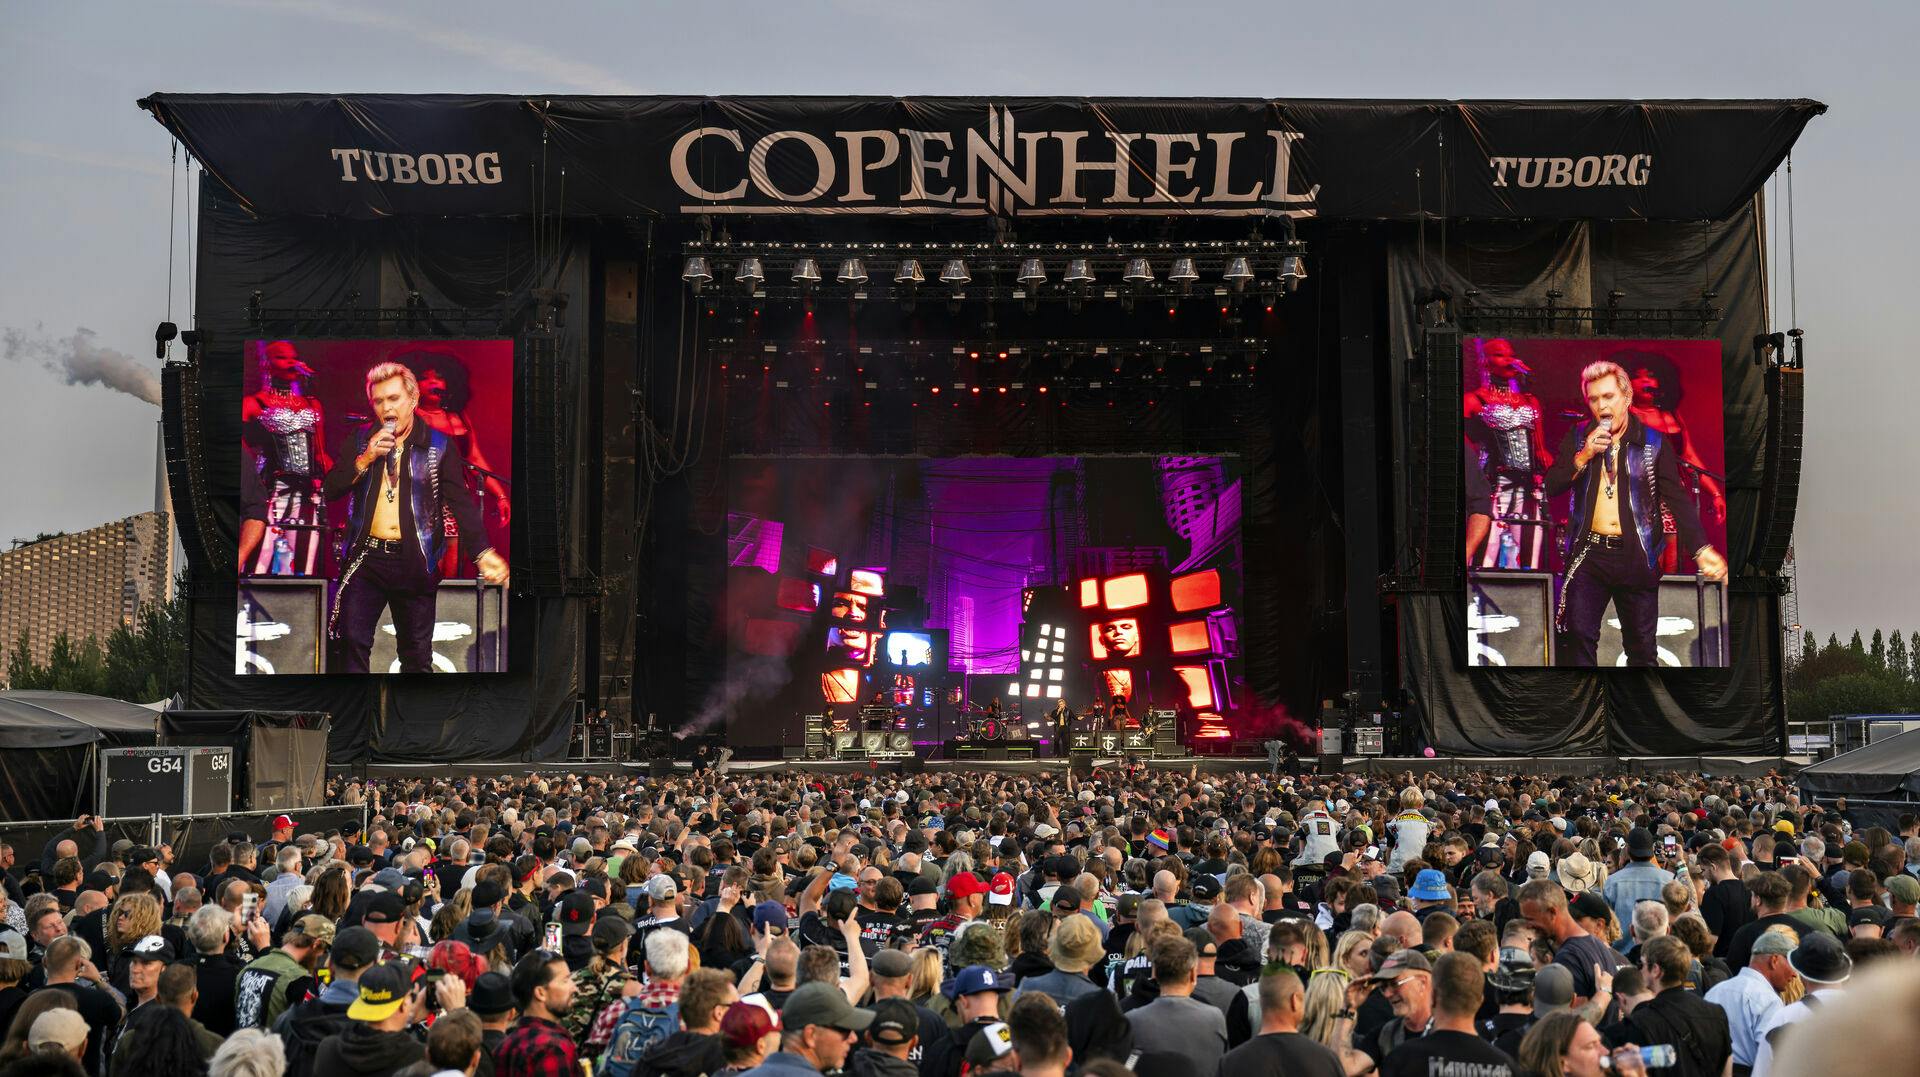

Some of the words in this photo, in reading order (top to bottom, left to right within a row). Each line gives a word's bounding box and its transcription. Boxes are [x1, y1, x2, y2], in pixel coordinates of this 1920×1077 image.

[331, 148, 503, 186] TUBORG
[669, 103, 1321, 216] COPENHELL
[1489, 153, 1652, 188] TUBORG
[147, 757, 183, 773] G54
[211, 755, 228, 771] G54
[1123, 955, 1153, 974] PAN
